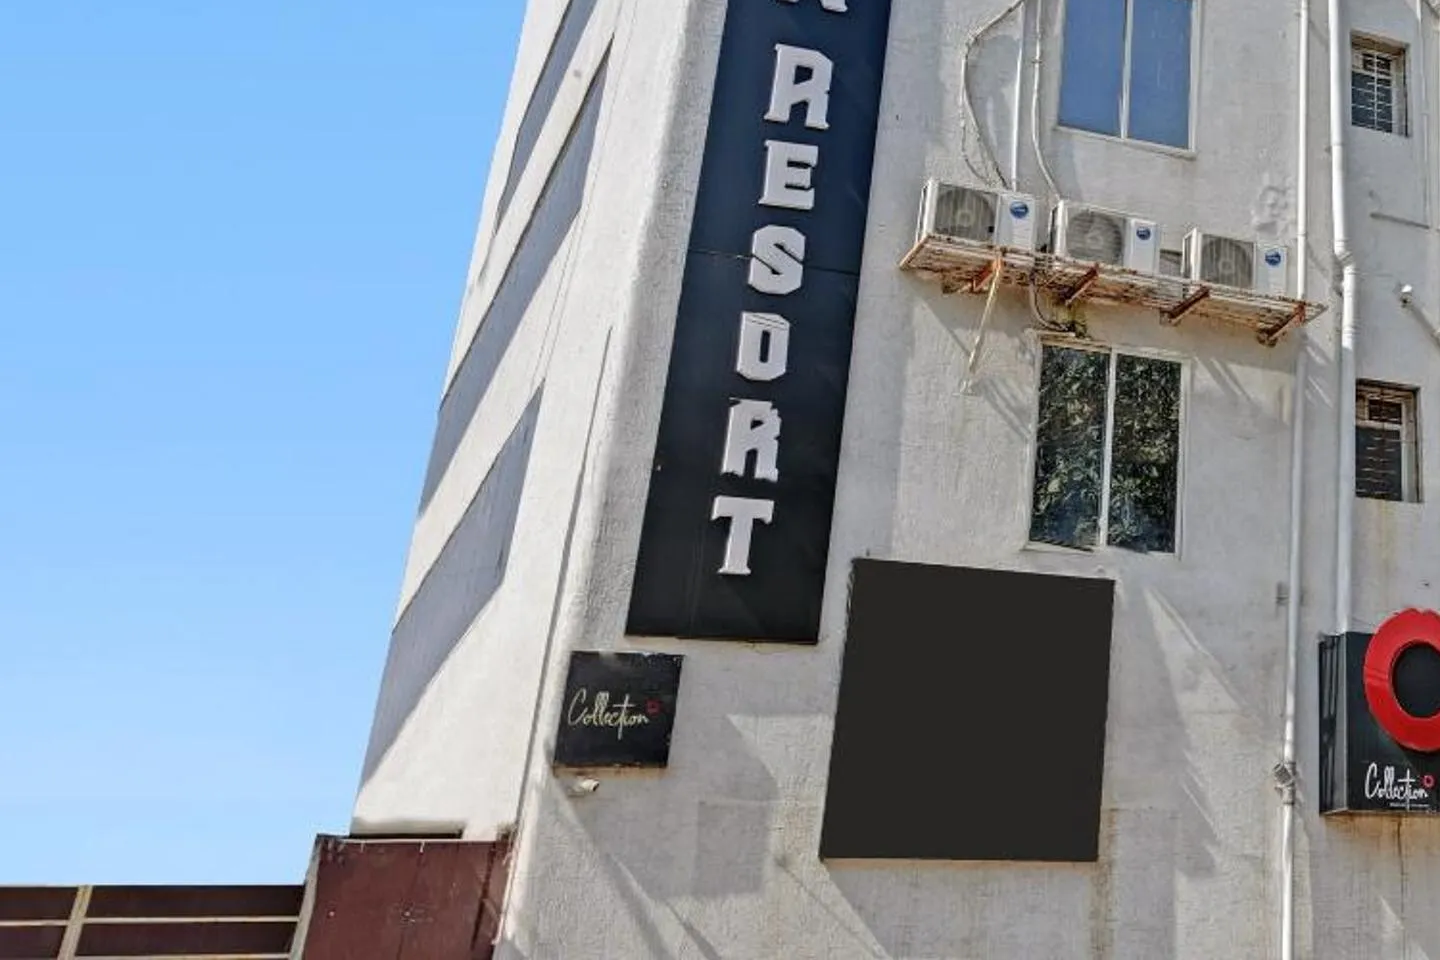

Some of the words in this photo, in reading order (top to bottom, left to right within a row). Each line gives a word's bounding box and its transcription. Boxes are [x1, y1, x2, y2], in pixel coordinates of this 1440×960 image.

[710, 42, 835, 576] RESORT
[567, 687, 650, 740] Collection
[1364, 762, 1429, 812] Collection
